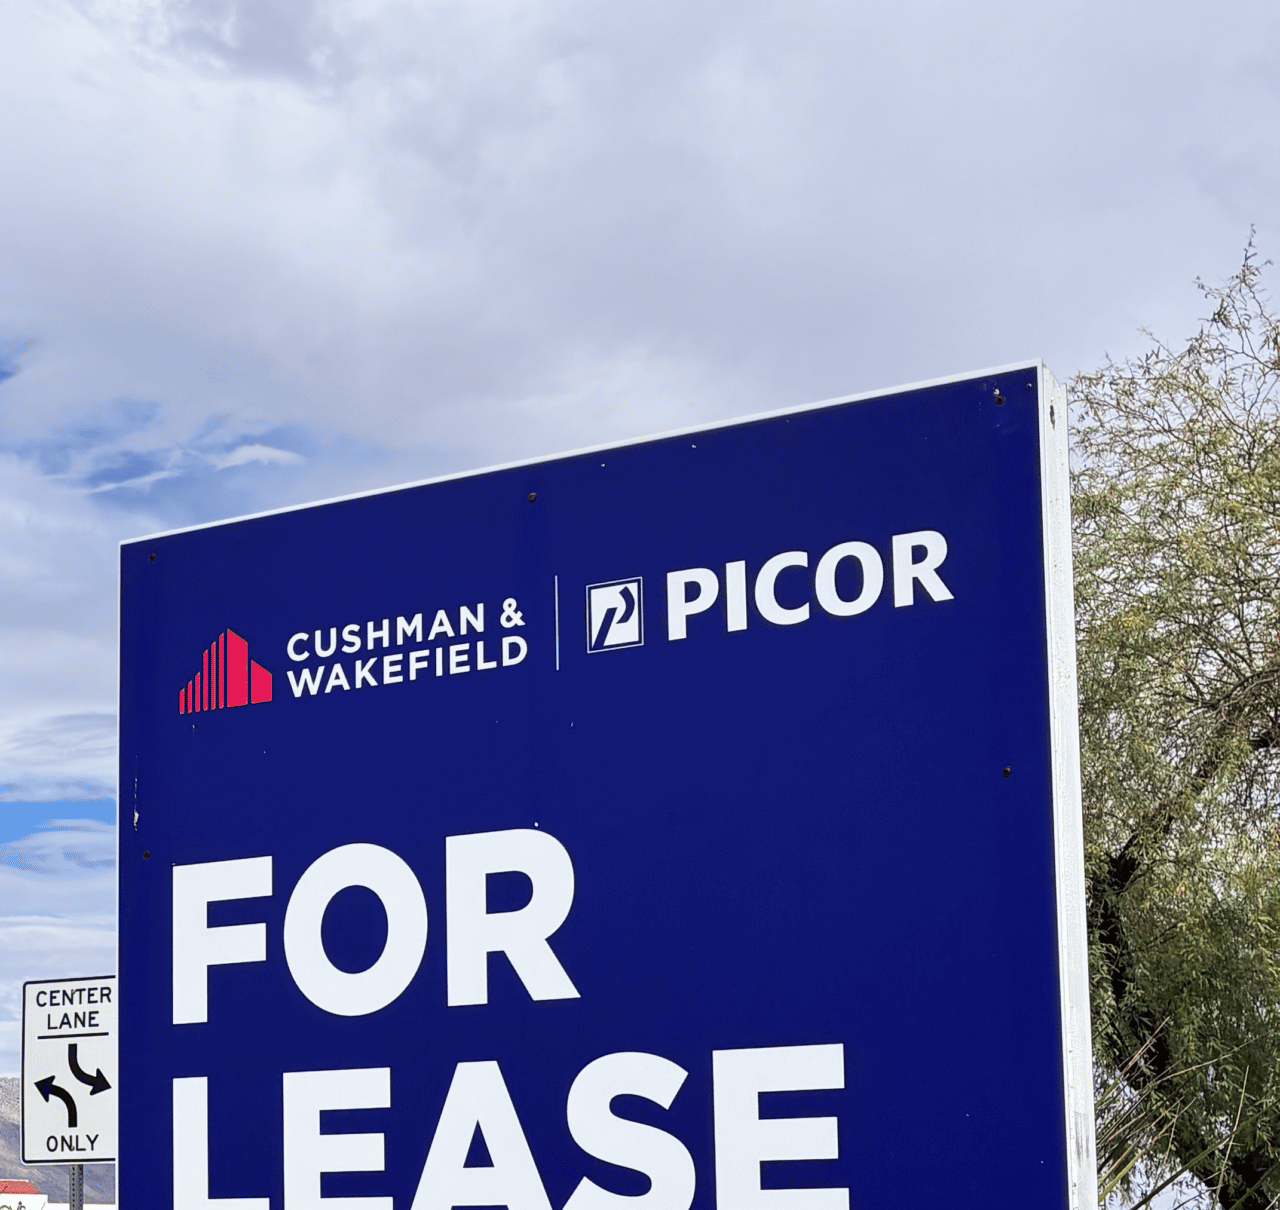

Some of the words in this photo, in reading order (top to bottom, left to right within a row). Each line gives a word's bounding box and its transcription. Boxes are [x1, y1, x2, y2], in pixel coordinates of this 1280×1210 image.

[665, 529, 955, 641] PICOR
[286, 603, 485, 662] CUSHMAN
[499, 597, 526, 629] &
[286, 635, 528, 698] WAKEFIELD
[172, 828, 581, 1025] FOR
[35, 986, 112, 1008] CENTER
[47, 1010, 100, 1030] LANE
[46, 1133, 99, 1152] ONLY
